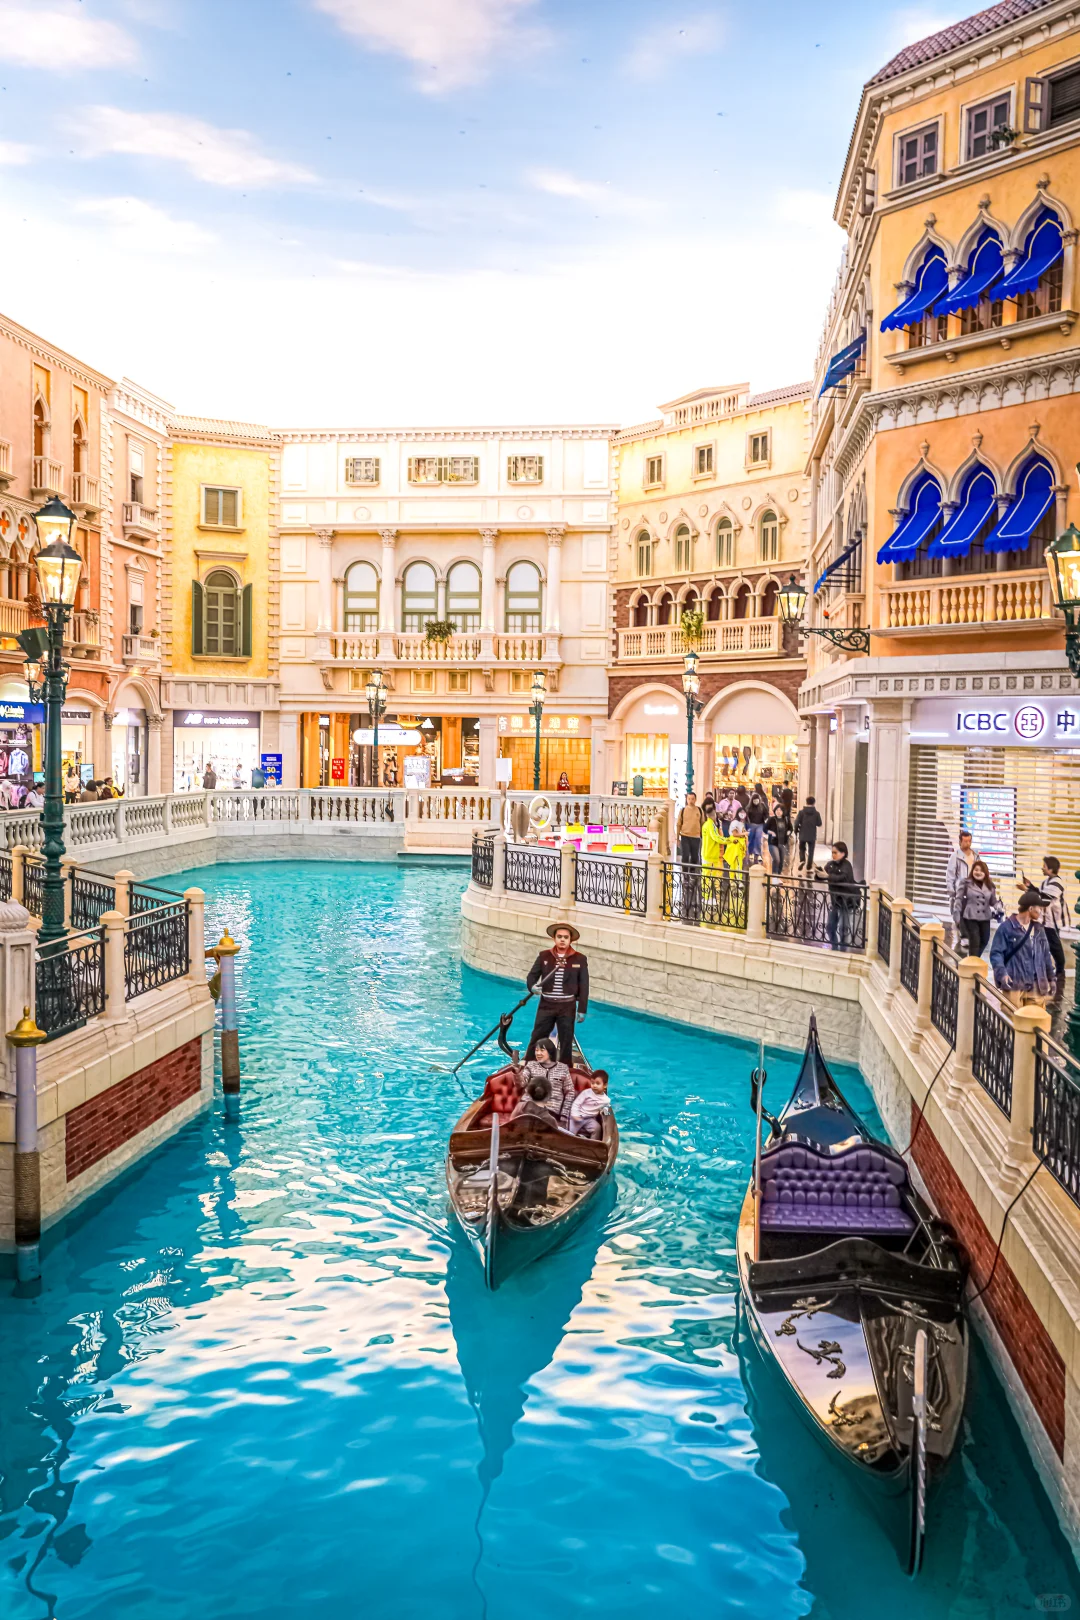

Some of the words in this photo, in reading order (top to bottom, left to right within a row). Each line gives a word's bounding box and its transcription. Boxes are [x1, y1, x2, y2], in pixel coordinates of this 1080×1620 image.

[219, 716, 249, 724] balance
[956, 713, 1007, 731] ICBC
[1056, 710, 1076, 732] 中
